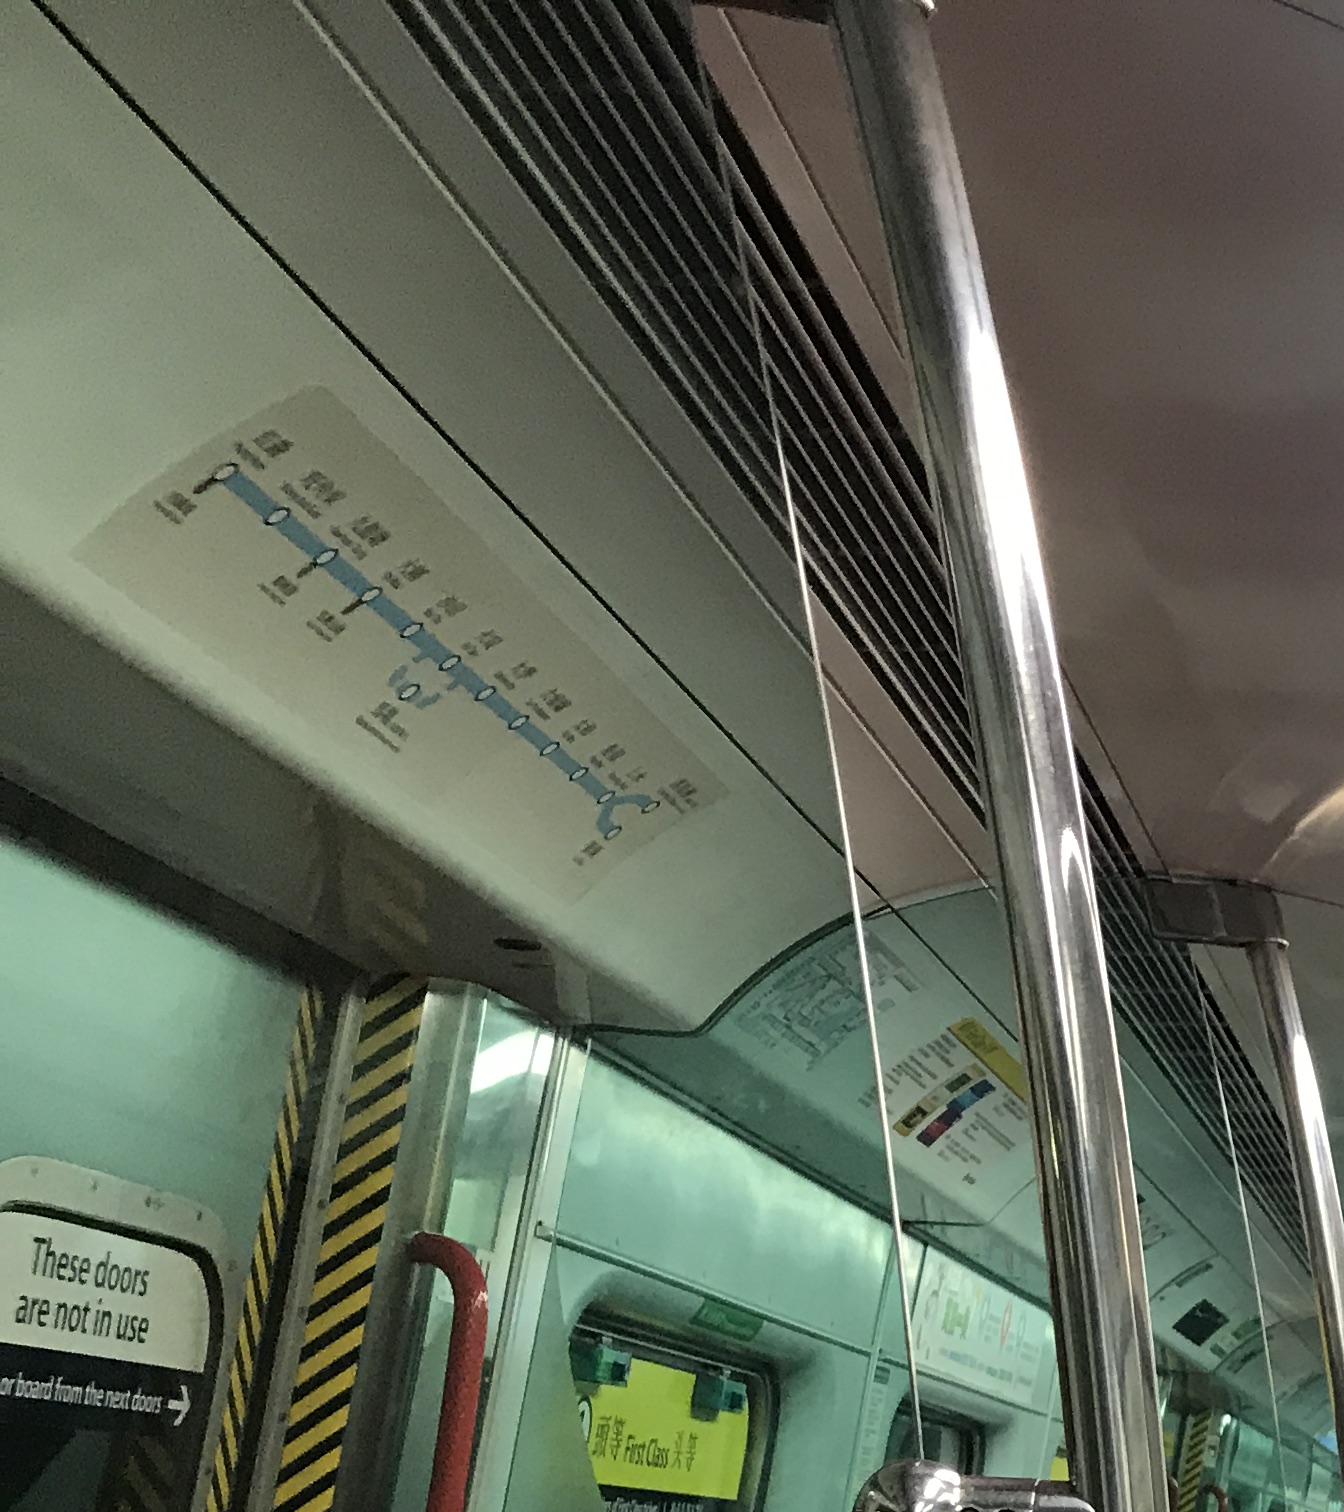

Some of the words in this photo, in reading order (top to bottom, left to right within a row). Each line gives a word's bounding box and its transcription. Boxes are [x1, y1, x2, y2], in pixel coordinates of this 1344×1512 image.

[32, 1236, 91, 1286] These
[94, 1250, 150, 1297] doors
[14, 1294, 50, 1328] are
[53, 1301, 91, 1334] not
[92, 1298, 112, 1337] in
[116, 1312, 149, 1344] use
[15, 1371, 55, 1400] board
[623, 1433, 646, 1465] First
[646, 1437, 669, 1469] Class
